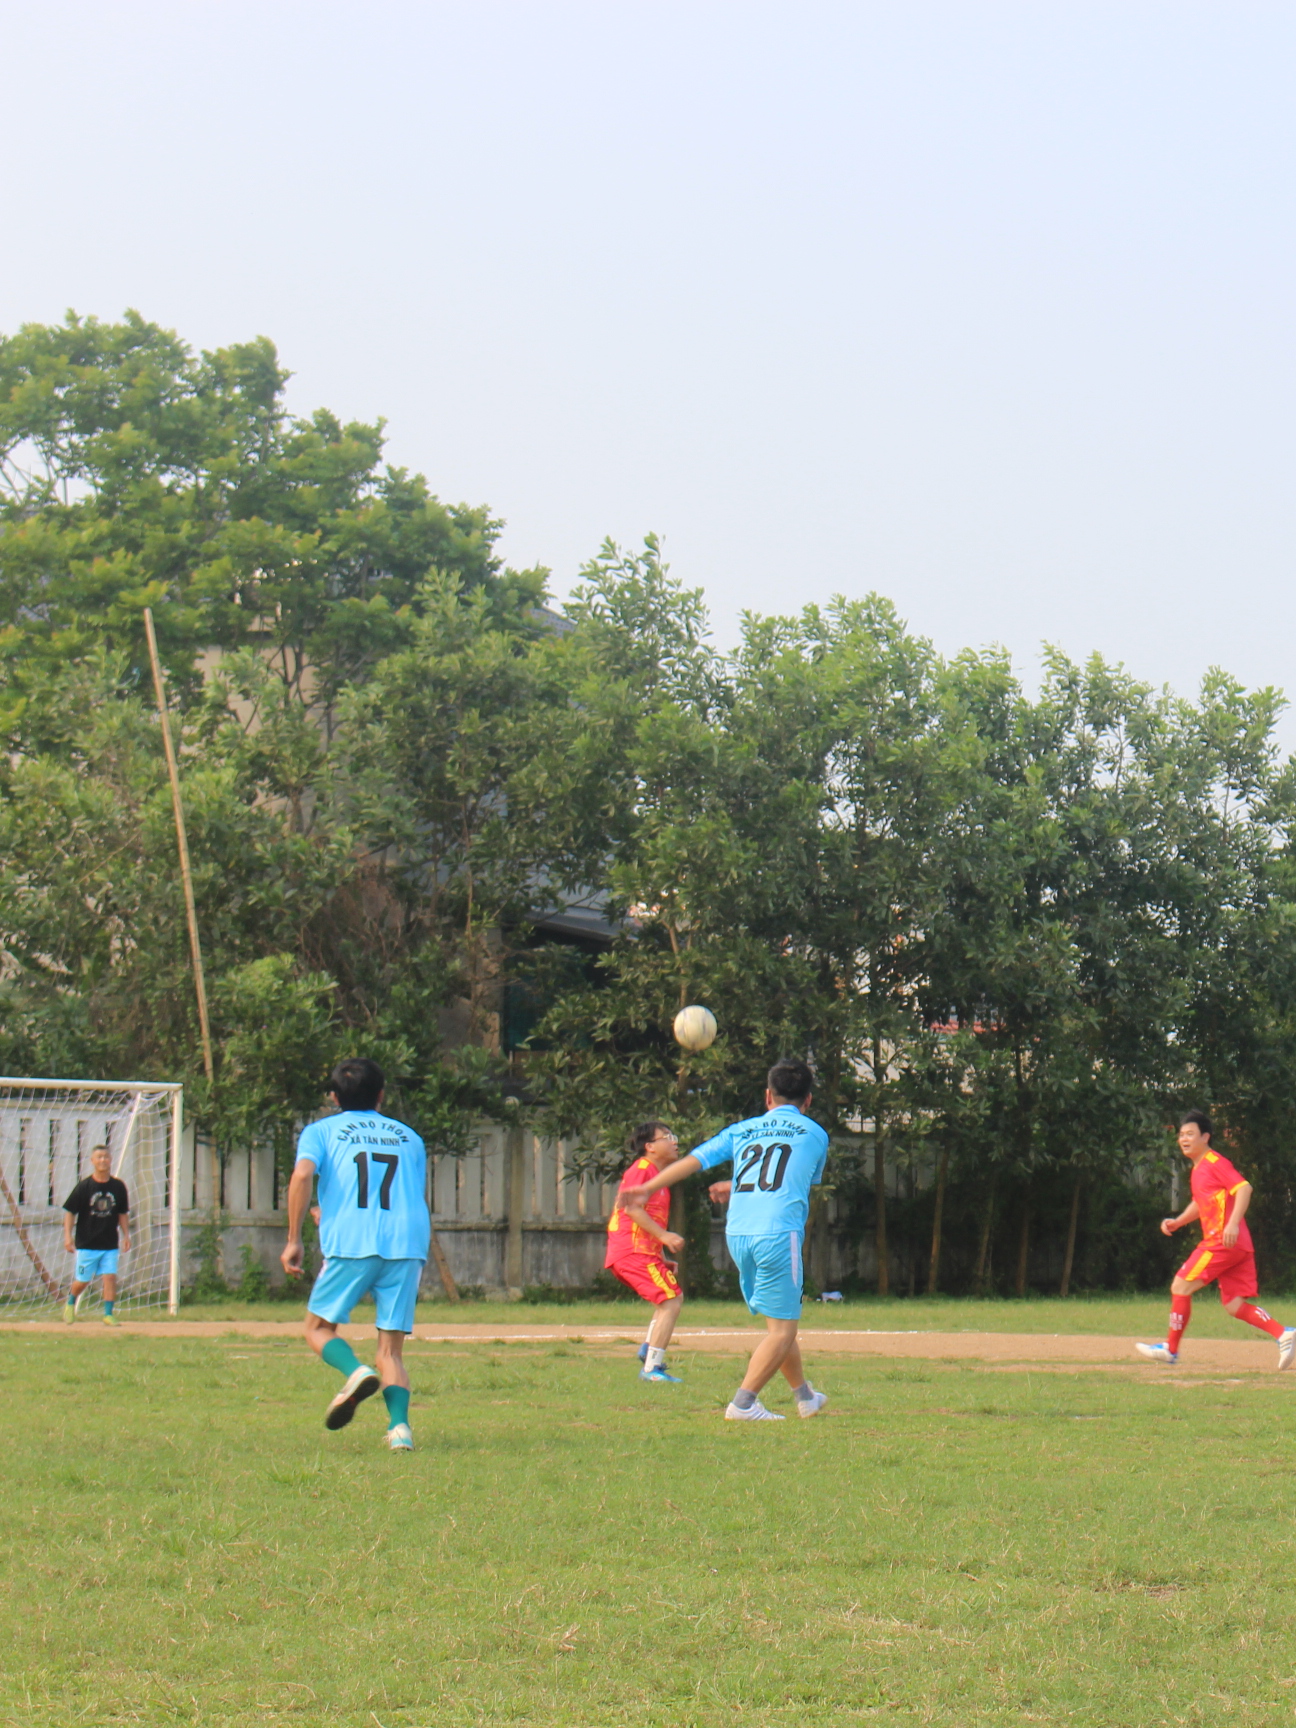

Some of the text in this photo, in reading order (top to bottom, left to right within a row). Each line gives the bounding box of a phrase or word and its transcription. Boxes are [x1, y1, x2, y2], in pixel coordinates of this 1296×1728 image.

[353, 1151, 399, 1211] 17
[734, 1142, 793, 1193] 20
[666, 1269, 677, 1285] 6
